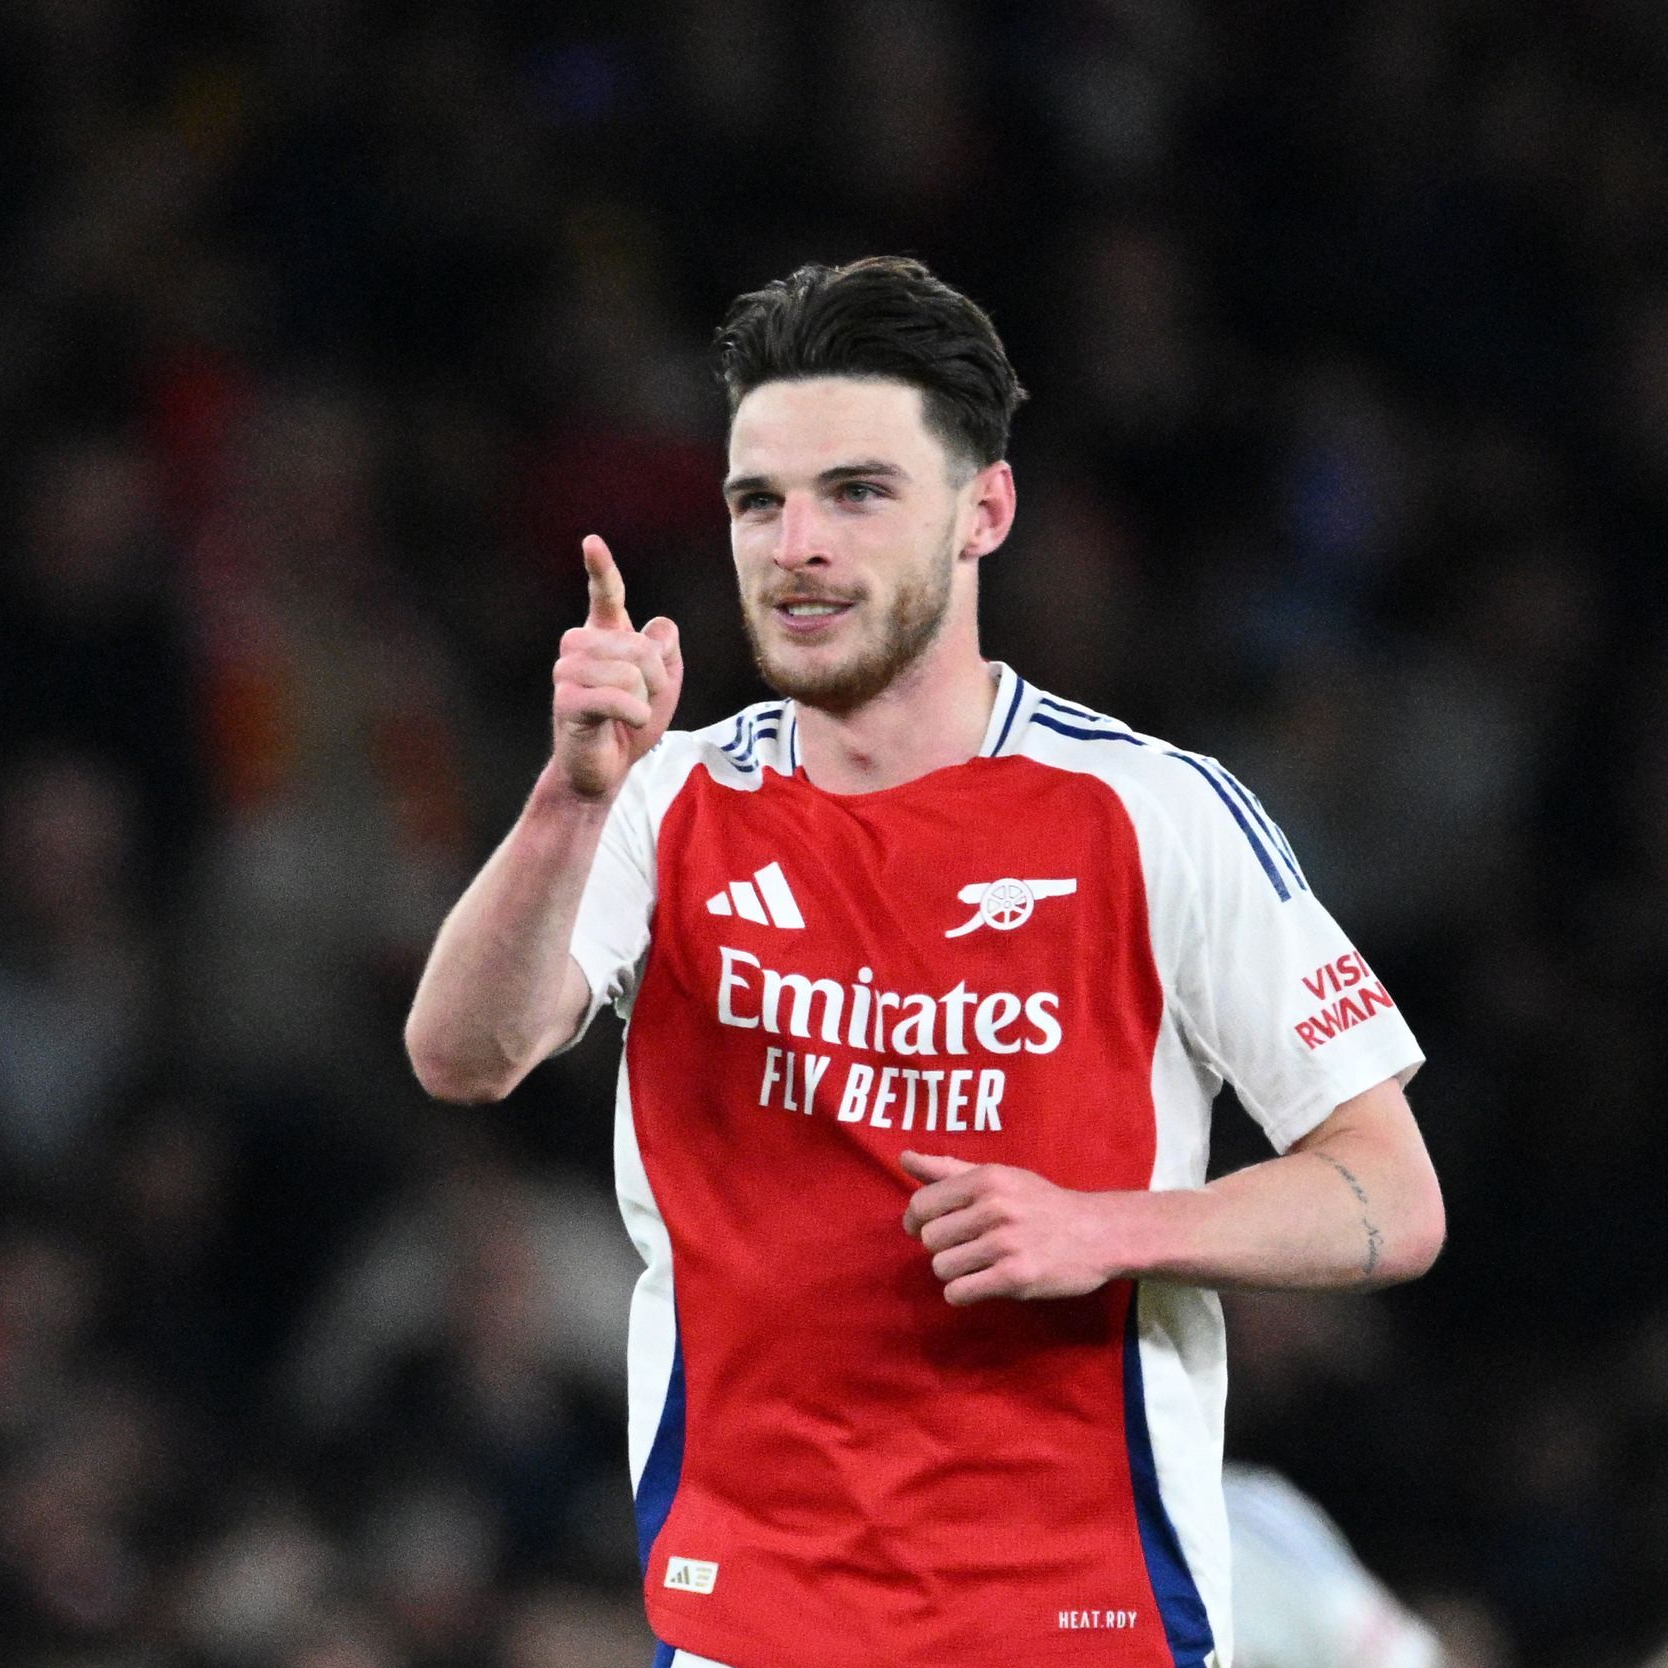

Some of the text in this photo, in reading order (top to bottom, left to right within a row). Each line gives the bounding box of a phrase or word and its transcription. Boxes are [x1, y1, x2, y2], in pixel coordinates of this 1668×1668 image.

[719, 945, 1063, 1056] Emirates
[1301, 950, 1370, 1001] VISI
[1294, 980, 1394, 1051] RWAN
[759, 1046, 1006, 1132] FLY BETTER
[1058, 1610, 1138, 1629] HEAT.RDY
